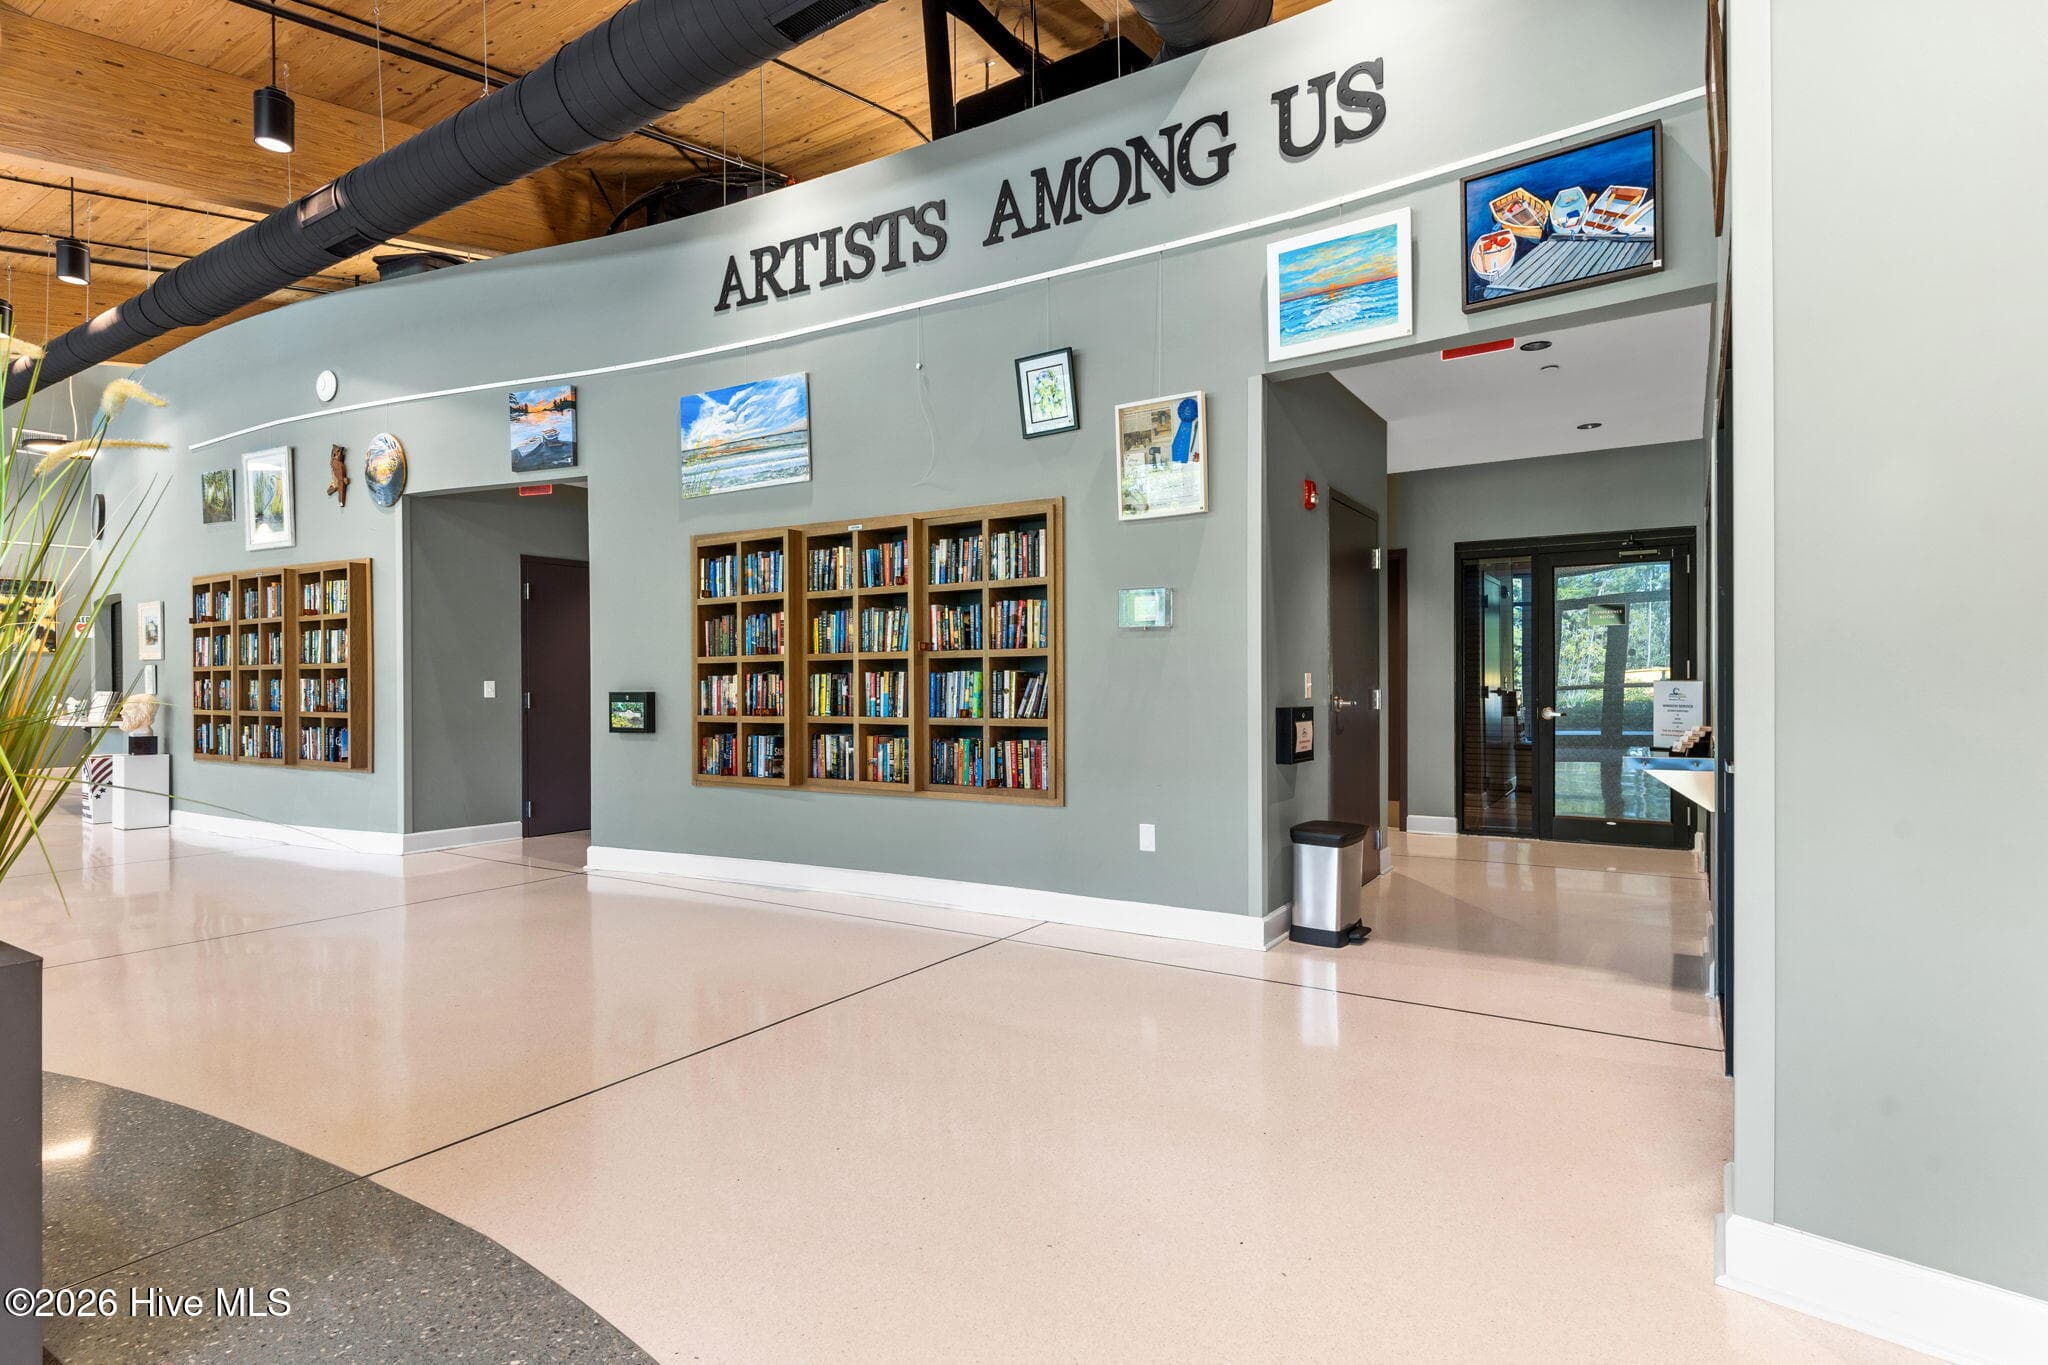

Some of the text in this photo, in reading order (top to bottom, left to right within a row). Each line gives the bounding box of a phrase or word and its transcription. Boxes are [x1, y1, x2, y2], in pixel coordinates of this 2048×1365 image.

[714, 56, 1387, 313] ARTISTS AMONG US
